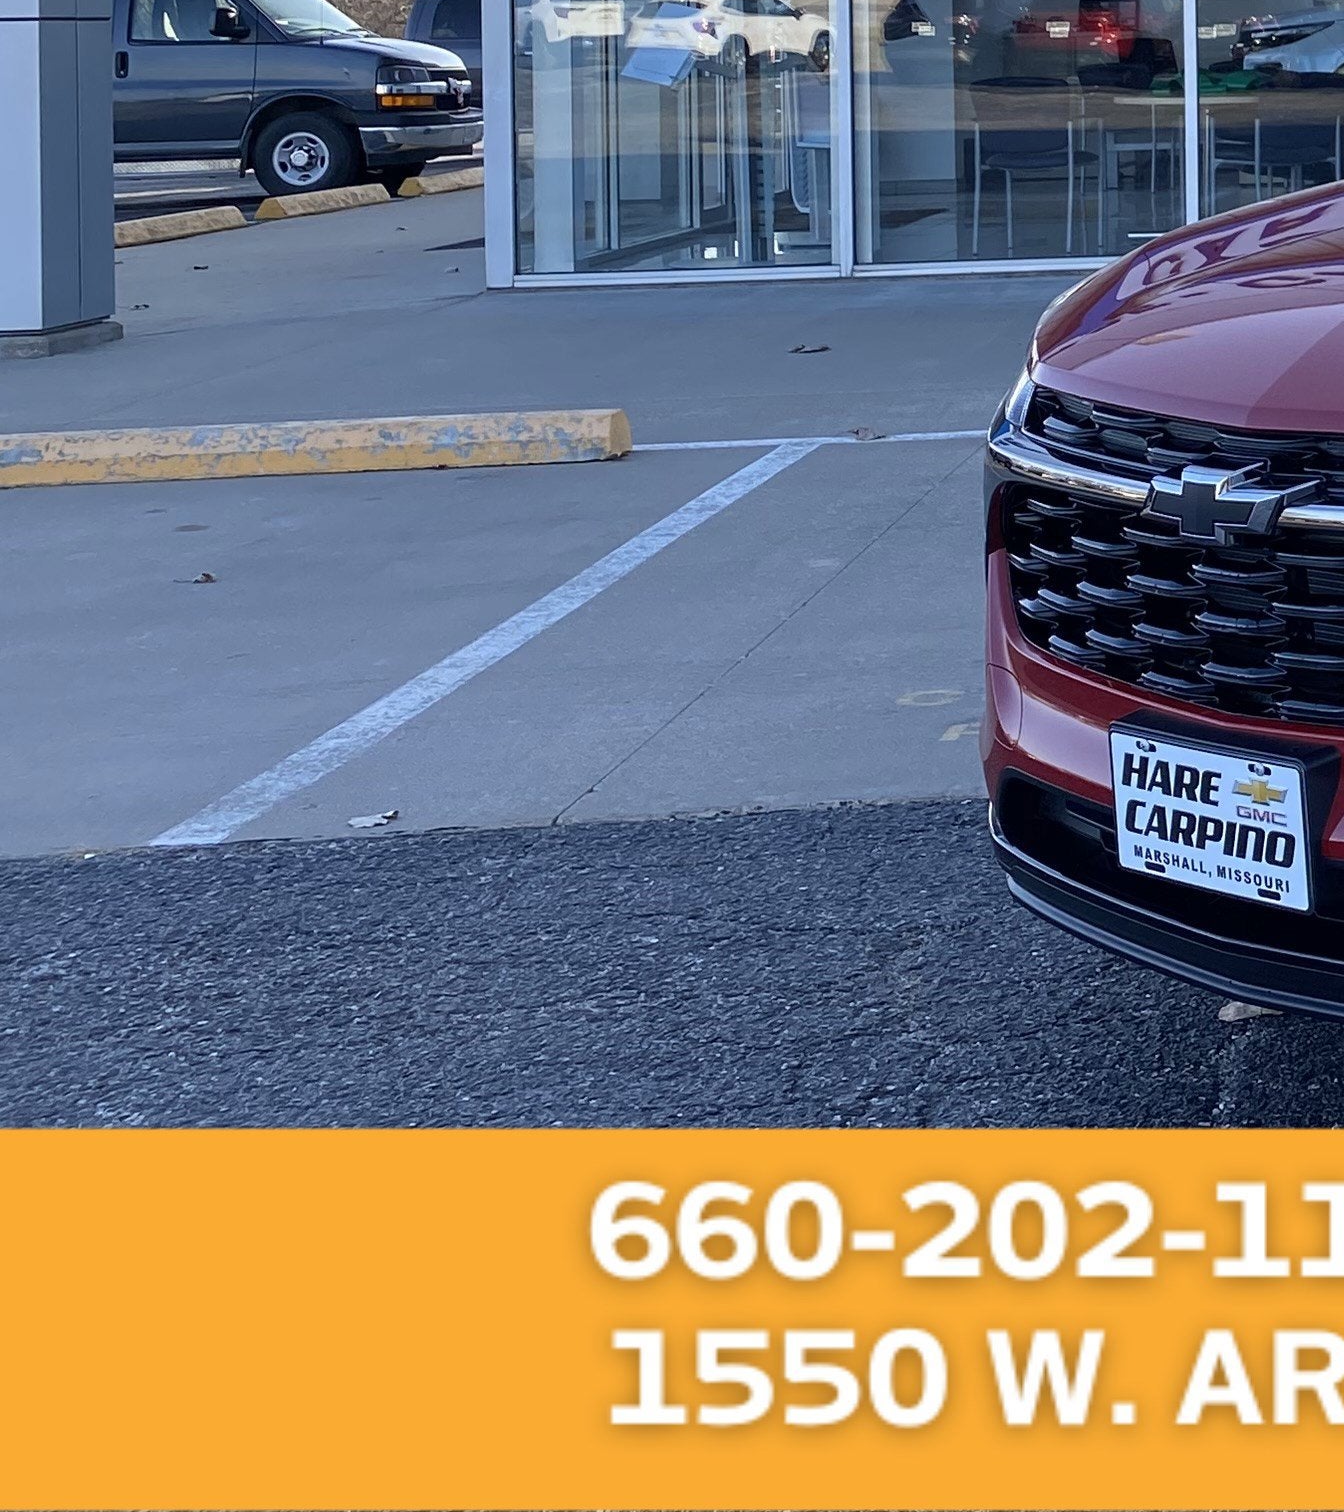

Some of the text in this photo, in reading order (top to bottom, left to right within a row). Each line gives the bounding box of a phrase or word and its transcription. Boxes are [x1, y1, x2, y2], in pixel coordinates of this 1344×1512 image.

[1121, 751, 1222, 807] HARE
[1125, 799, 1296, 869] CARPINO
[1235, 805, 1288, 828] GMC
[1133, 844, 1290, 893] MARSHALL, MISSOURI
